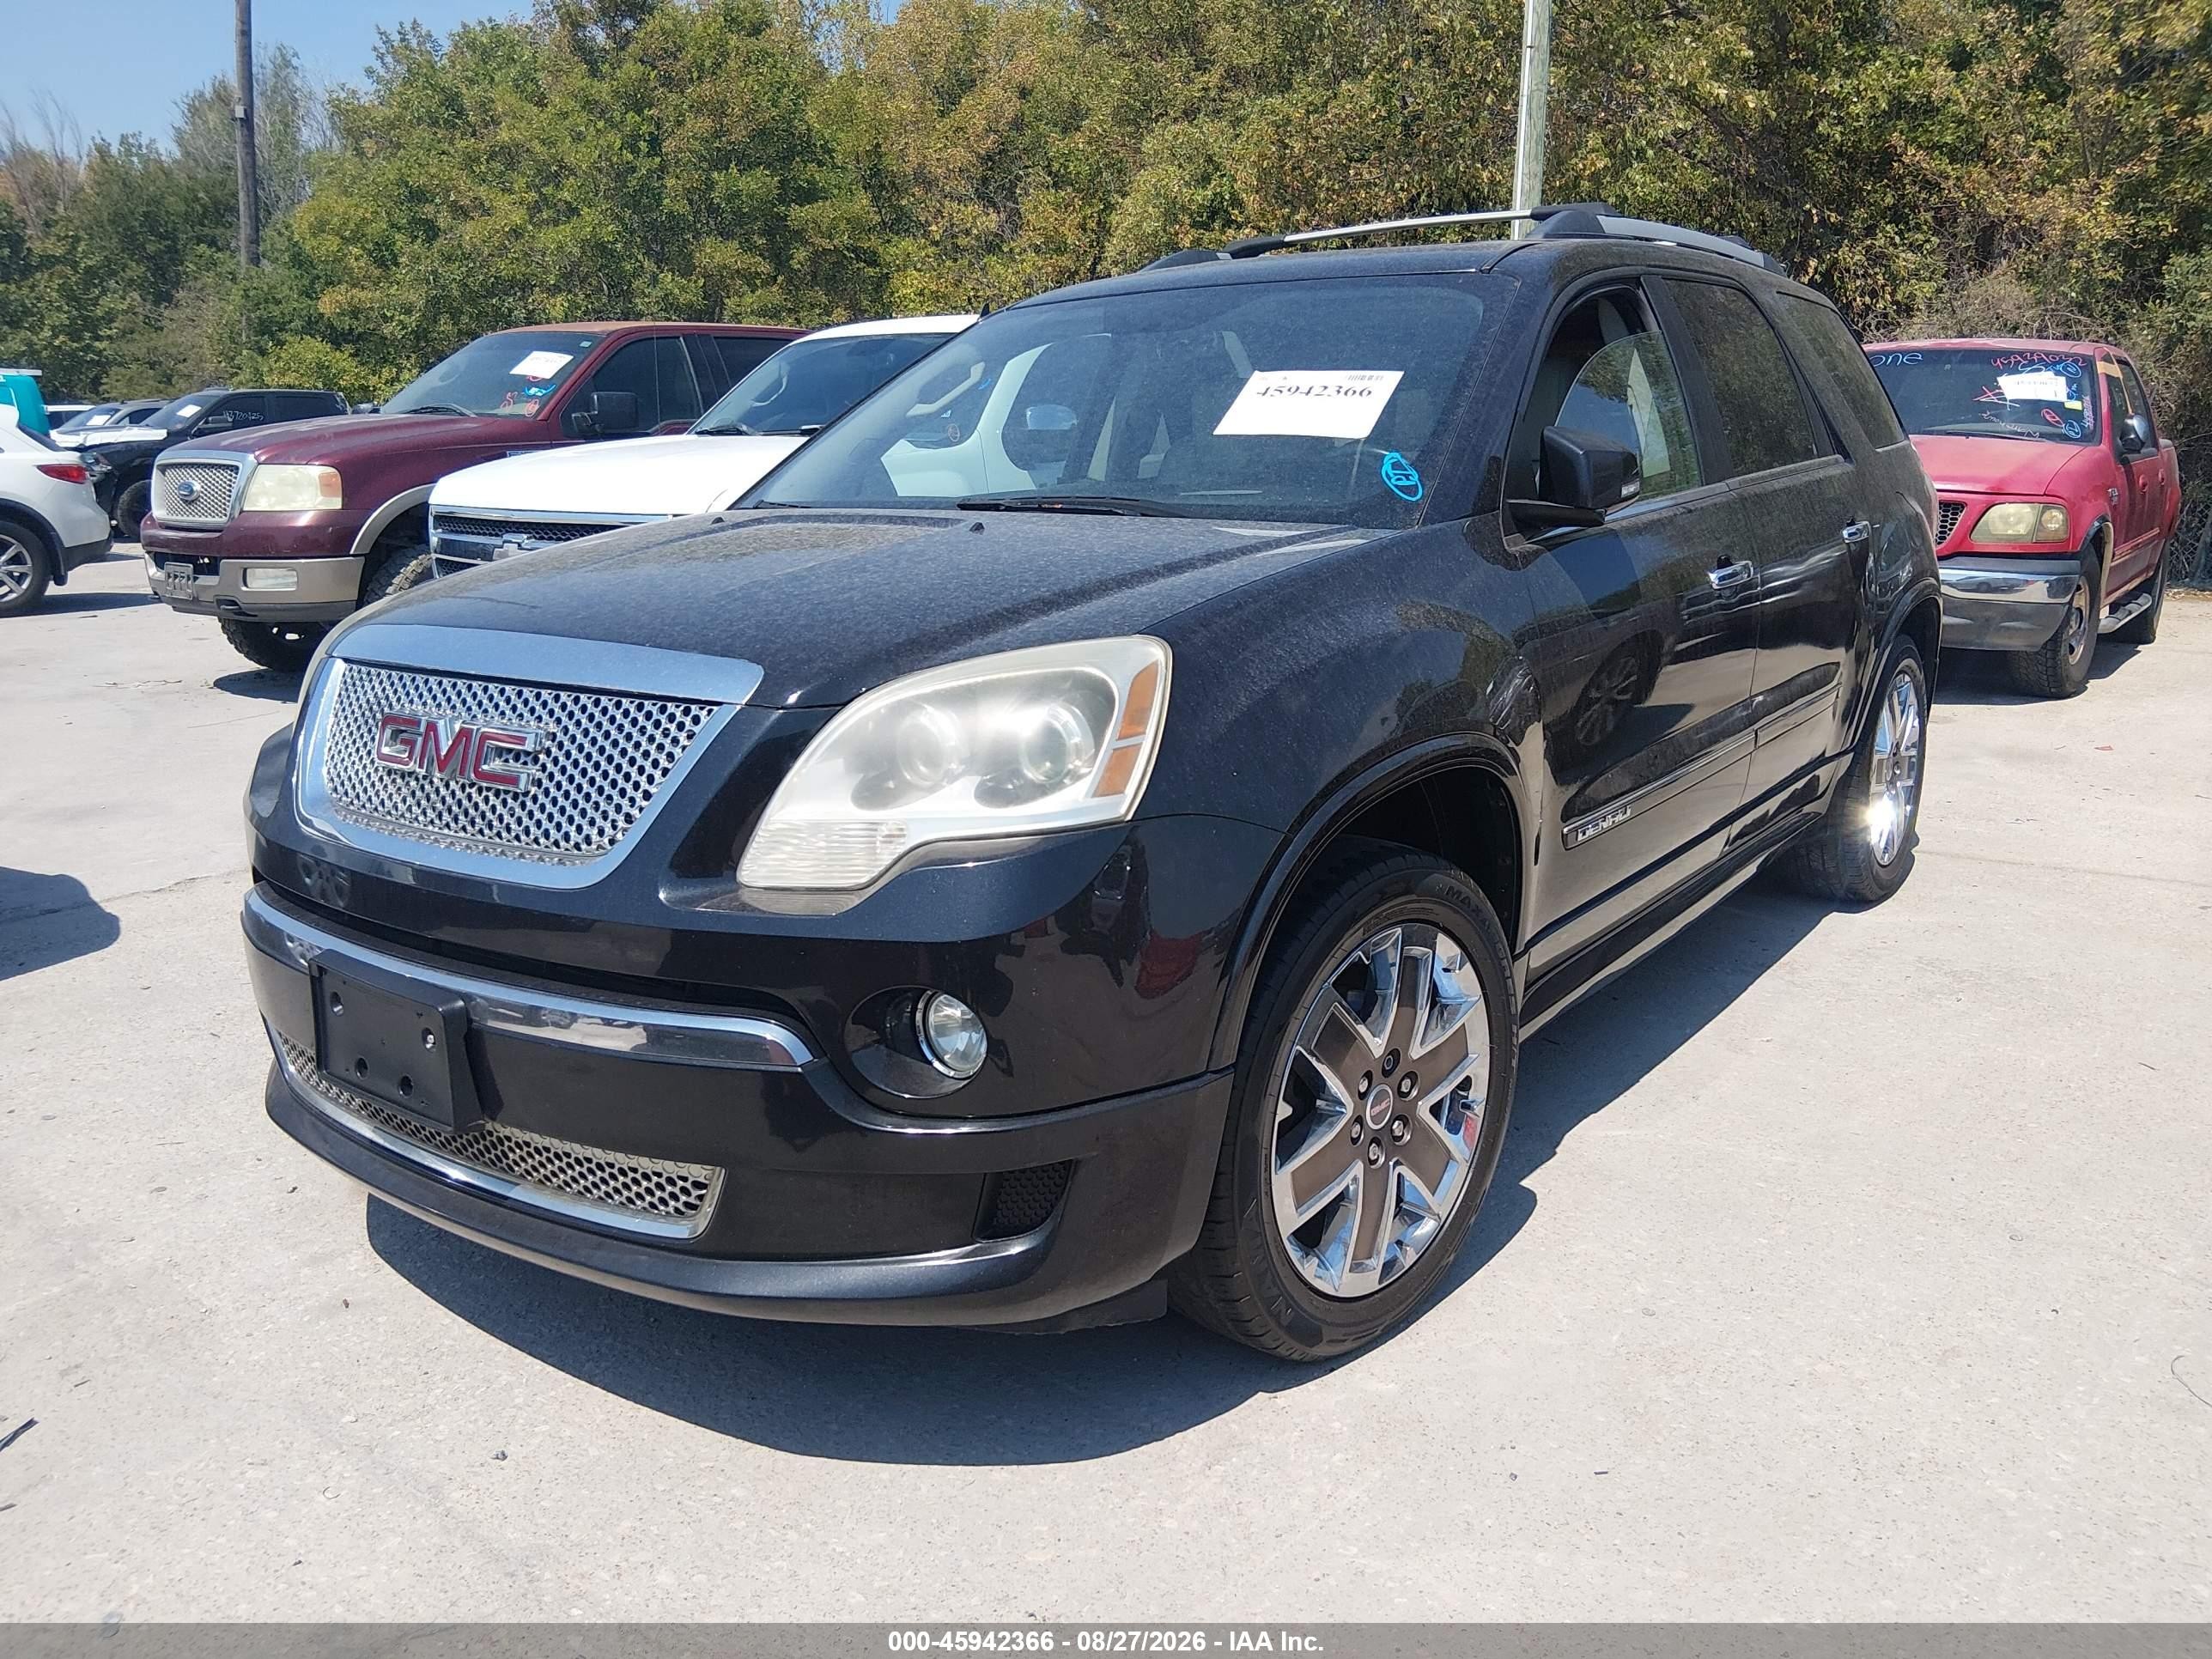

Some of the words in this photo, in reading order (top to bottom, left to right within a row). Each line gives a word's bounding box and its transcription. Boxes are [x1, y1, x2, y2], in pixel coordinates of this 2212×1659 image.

[1256, 385, 1373, 397] 45942366
[375, 709, 542, 793] GMC
[1577, 805, 1633, 842] DENALI
